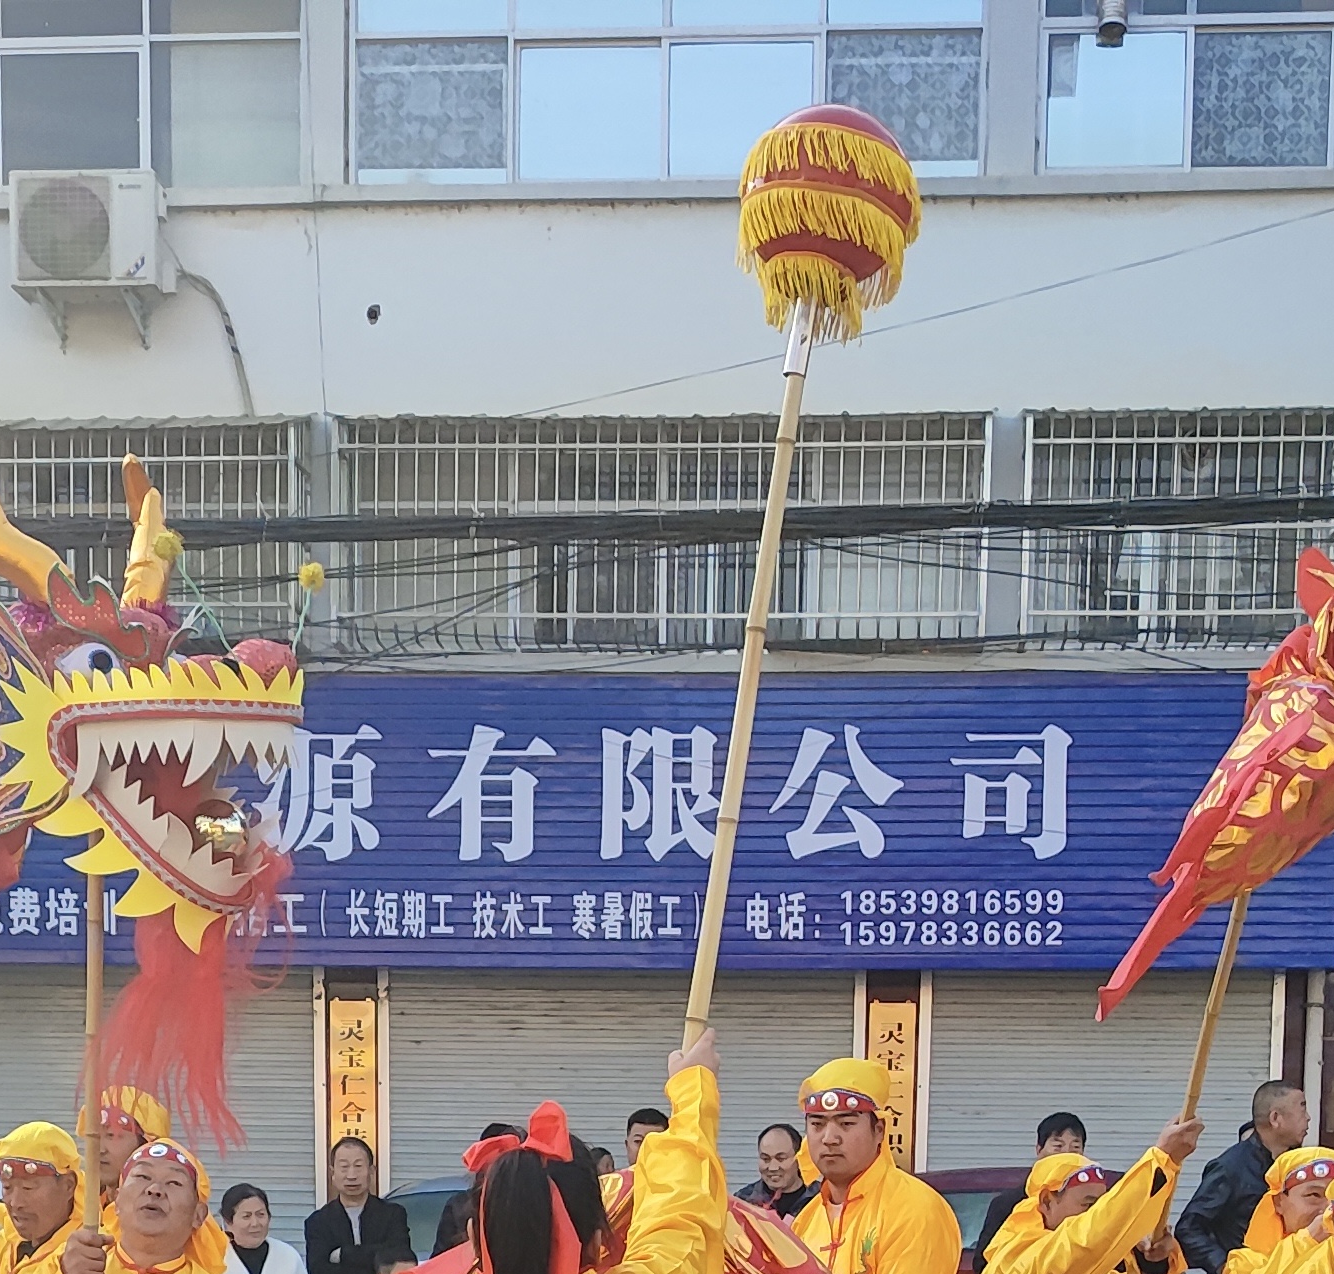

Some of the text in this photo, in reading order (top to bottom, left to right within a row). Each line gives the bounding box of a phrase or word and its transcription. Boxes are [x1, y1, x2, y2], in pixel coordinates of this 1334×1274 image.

[472, 890, 553, 939] 技术工
[839, 889, 1065, 916] 18539816599
[839, 921, 1064, 946] 15978336662
